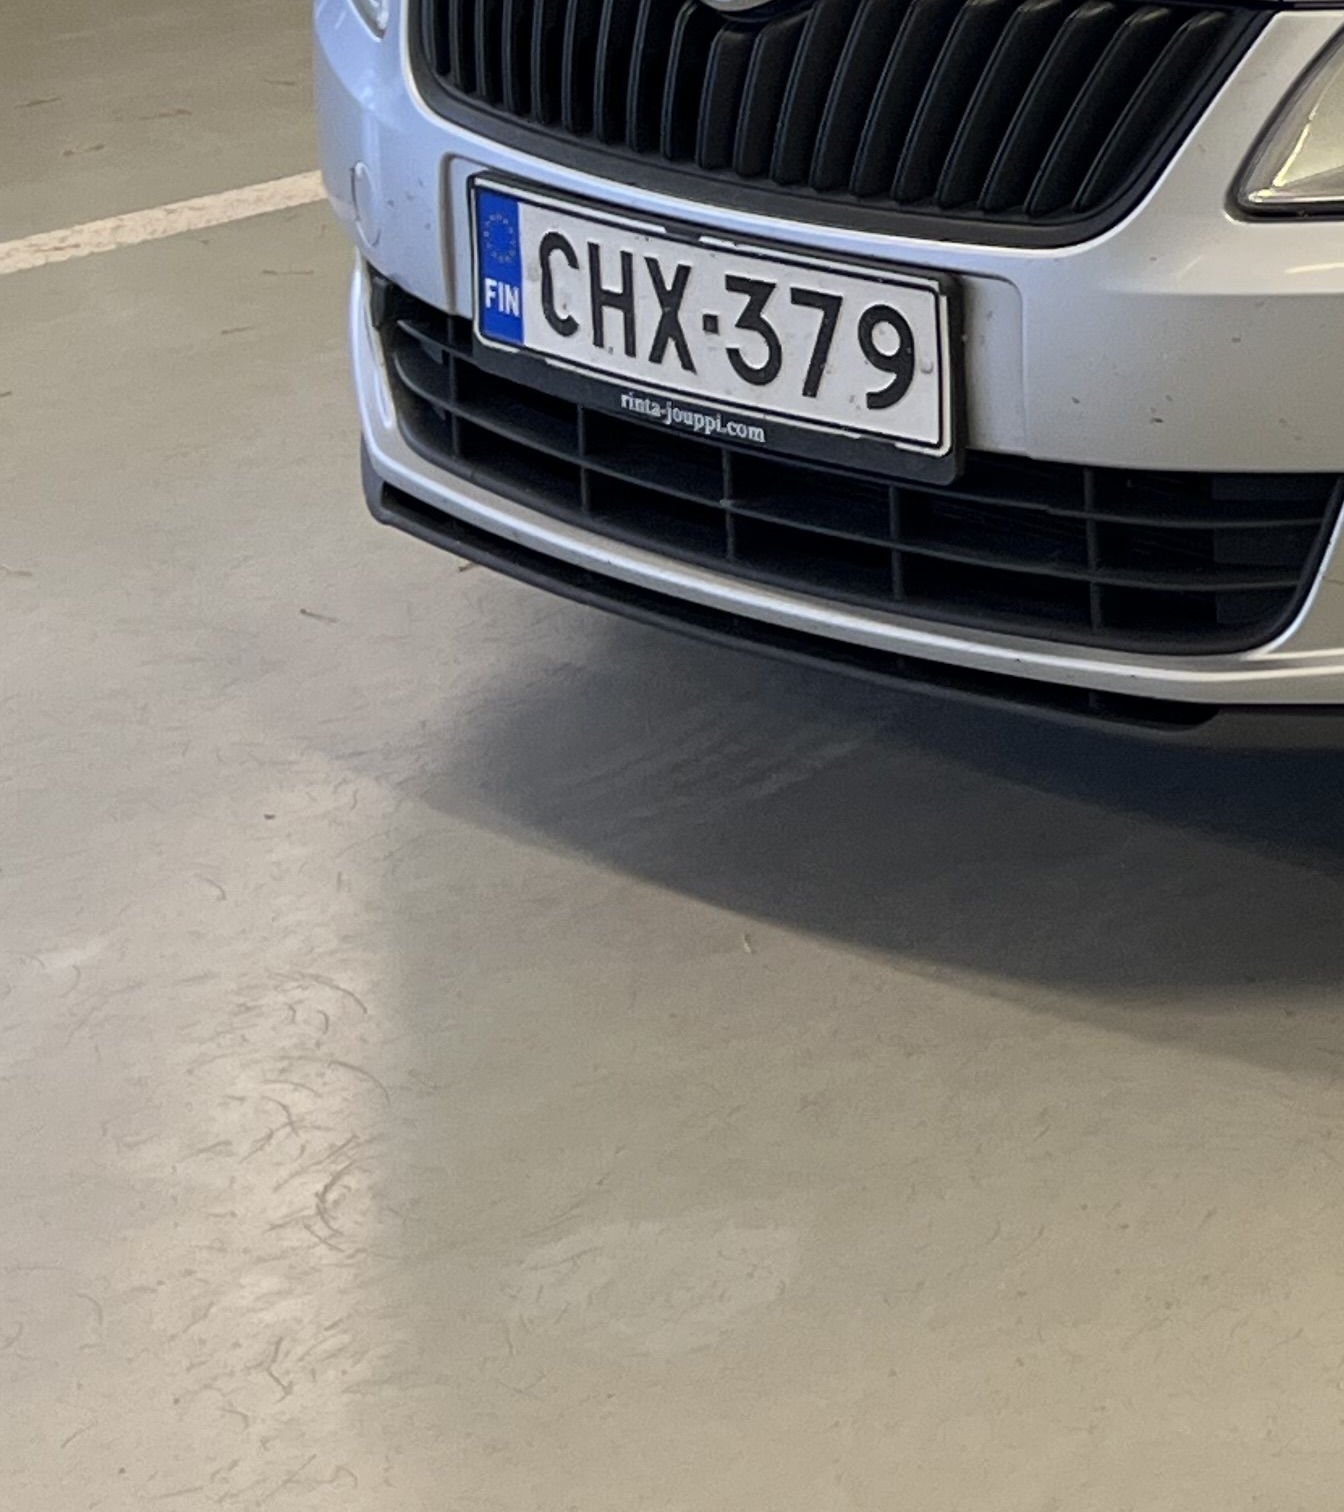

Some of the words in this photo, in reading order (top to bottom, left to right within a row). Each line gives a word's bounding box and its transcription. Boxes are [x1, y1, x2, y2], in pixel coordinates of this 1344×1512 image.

[484, 277, 520, 317] FIN
[538, 231, 915, 410] CHX-379
[620, 391, 766, 443] rinta-jouppi.com
